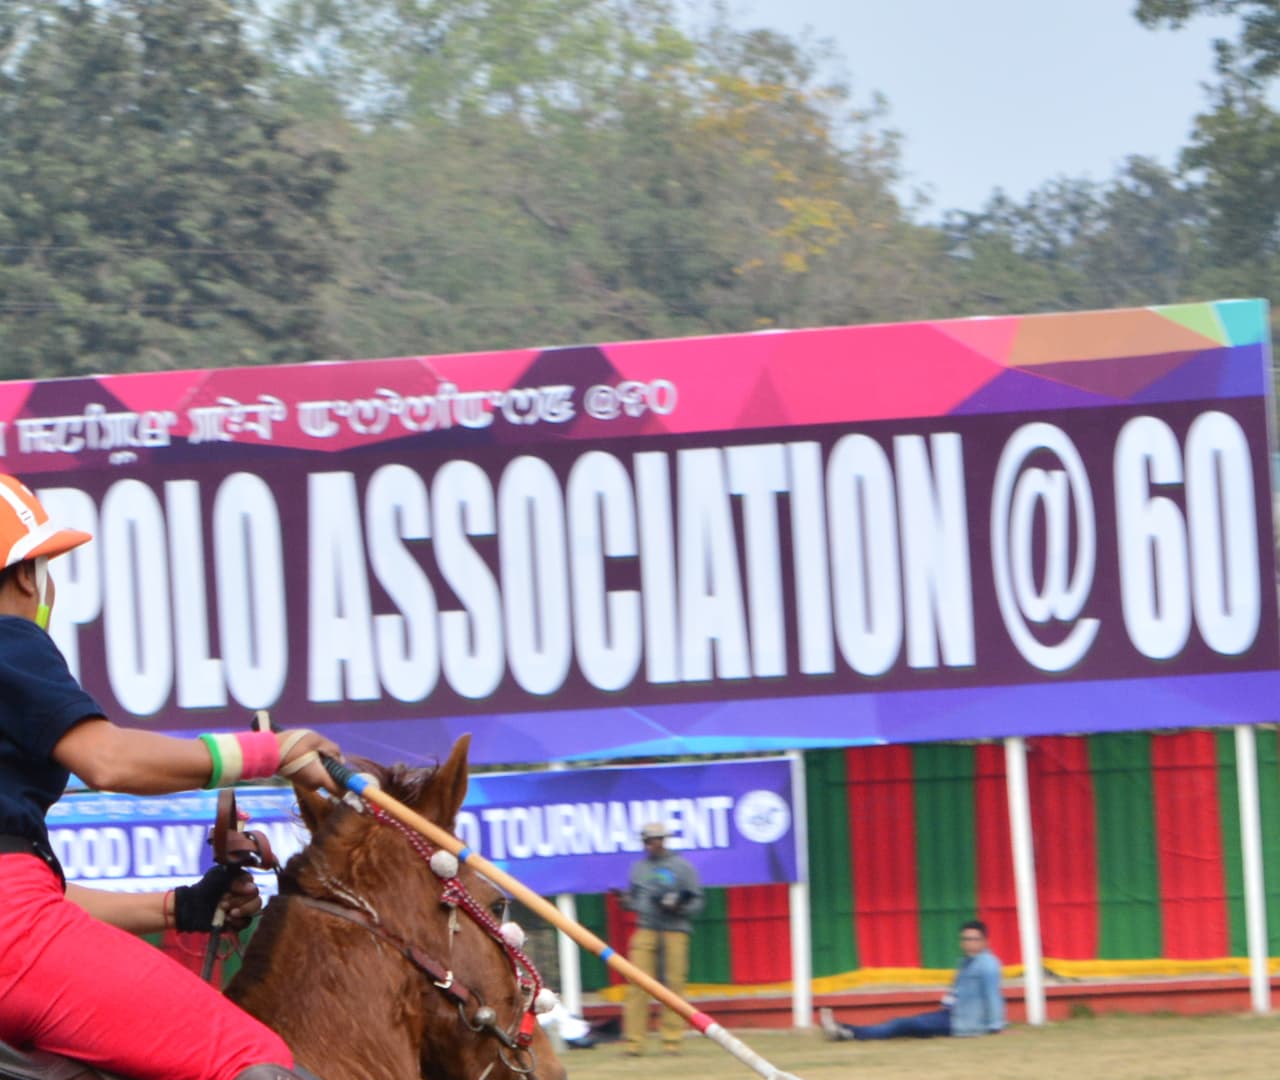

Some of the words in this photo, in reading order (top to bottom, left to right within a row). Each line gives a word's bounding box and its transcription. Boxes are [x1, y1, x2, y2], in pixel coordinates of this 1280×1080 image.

[36, 472, 289, 716] POLO
[307, 432, 976, 703] ASSOCIATION
[990, 422, 1101, 672] @
[1113, 410, 1261, 660] 60
[132, 825, 205, 876] DAY
[482, 796, 734, 860] TOURNAMENT
